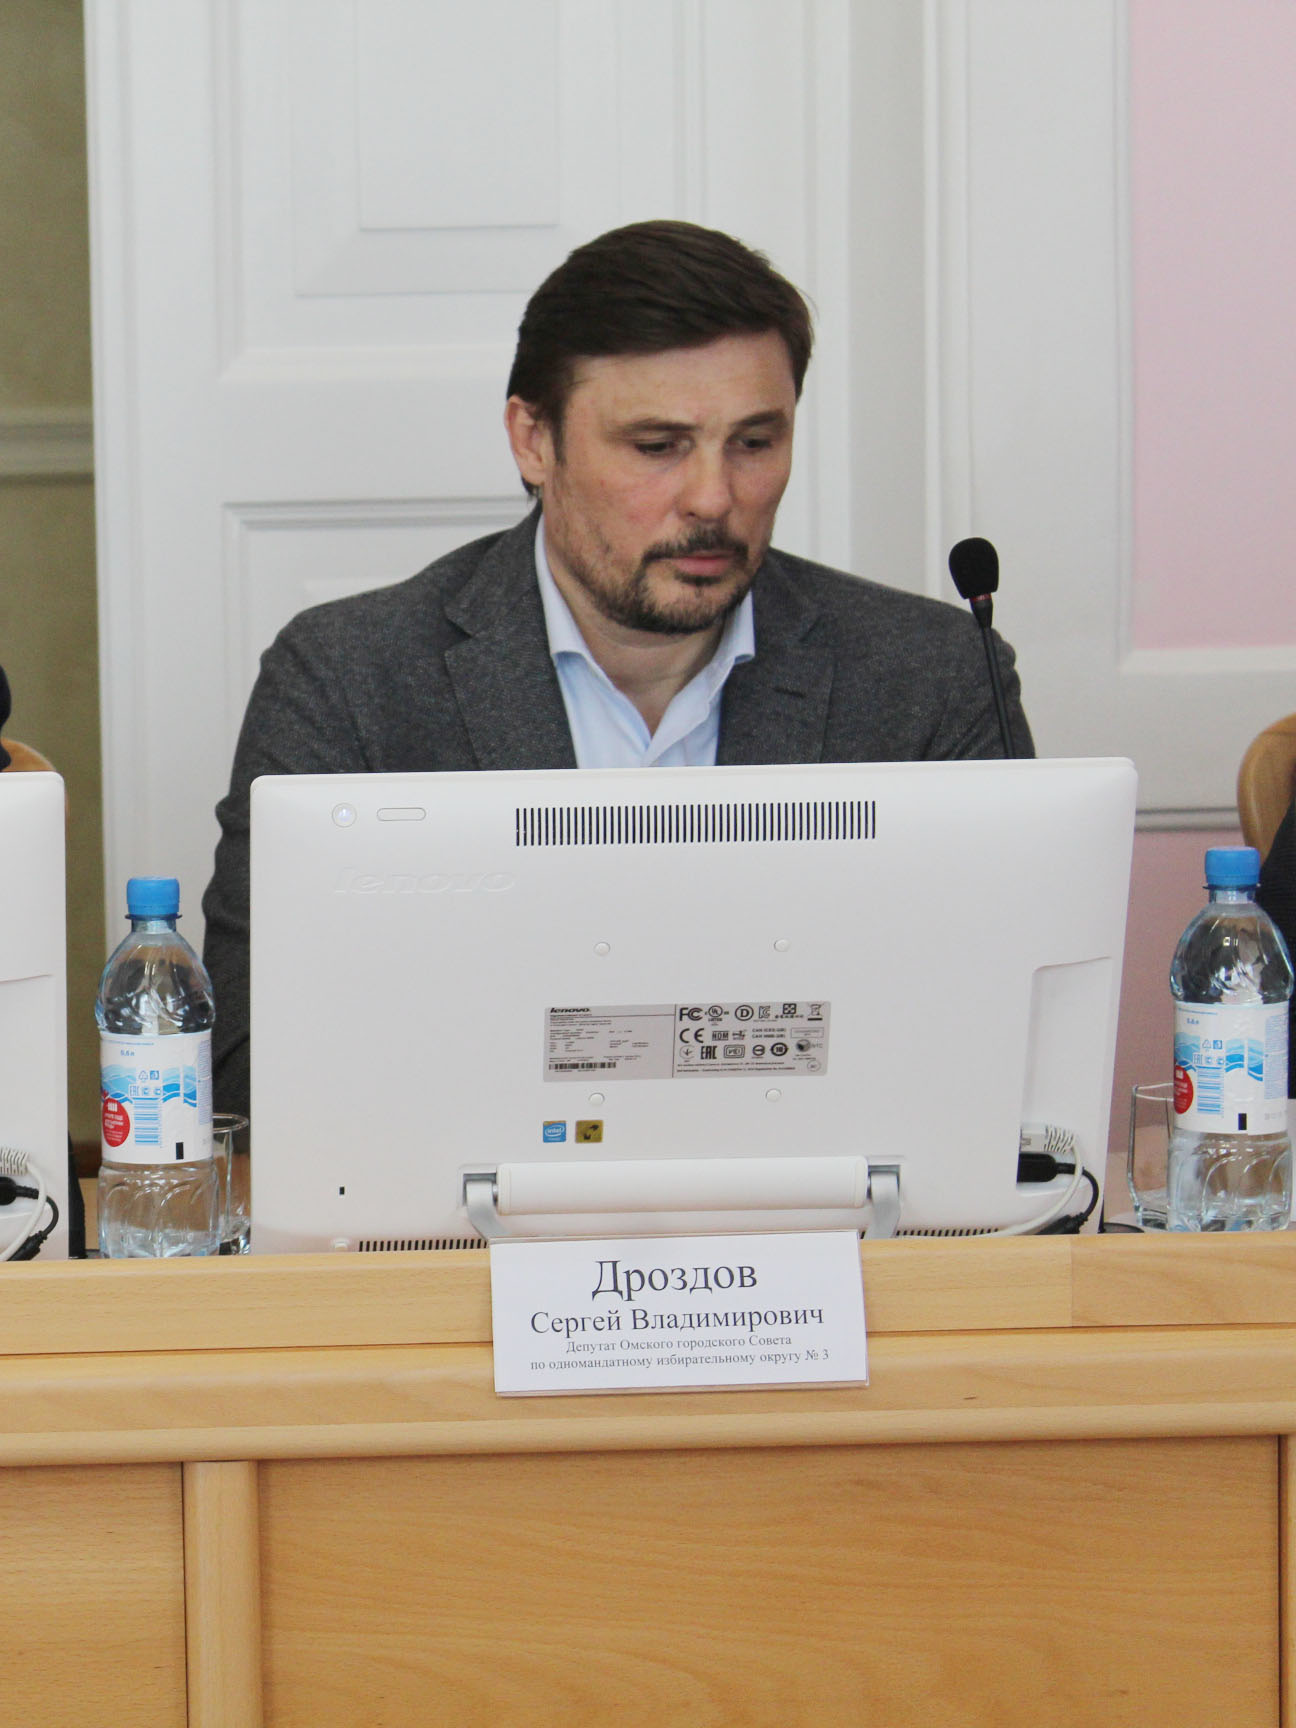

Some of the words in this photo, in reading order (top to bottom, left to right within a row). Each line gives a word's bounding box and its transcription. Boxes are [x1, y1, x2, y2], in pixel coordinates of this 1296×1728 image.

[680, 1028, 704, 1043] CE
[592, 1260, 757, 1301] Дроздов
[531, 1310, 621, 1338] Сергей
[632, 1308, 824, 1332] Владимирович
[566, 1341, 616, 1354] Депутат
[620, 1339, 673, 1350] Омского
[677, 1337, 745, 1350] городского
[749, 1335, 792, 1346] Совета
[531, 1361, 545, 1370] по
[549, 1357, 652, 1370] одномандатному
[656, 1354, 756, 1367] избирательному
[760, 1351, 801, 1364] округу
[805, 1350, 819, 1361] №
[822, 1349, 829, 1360] 3
